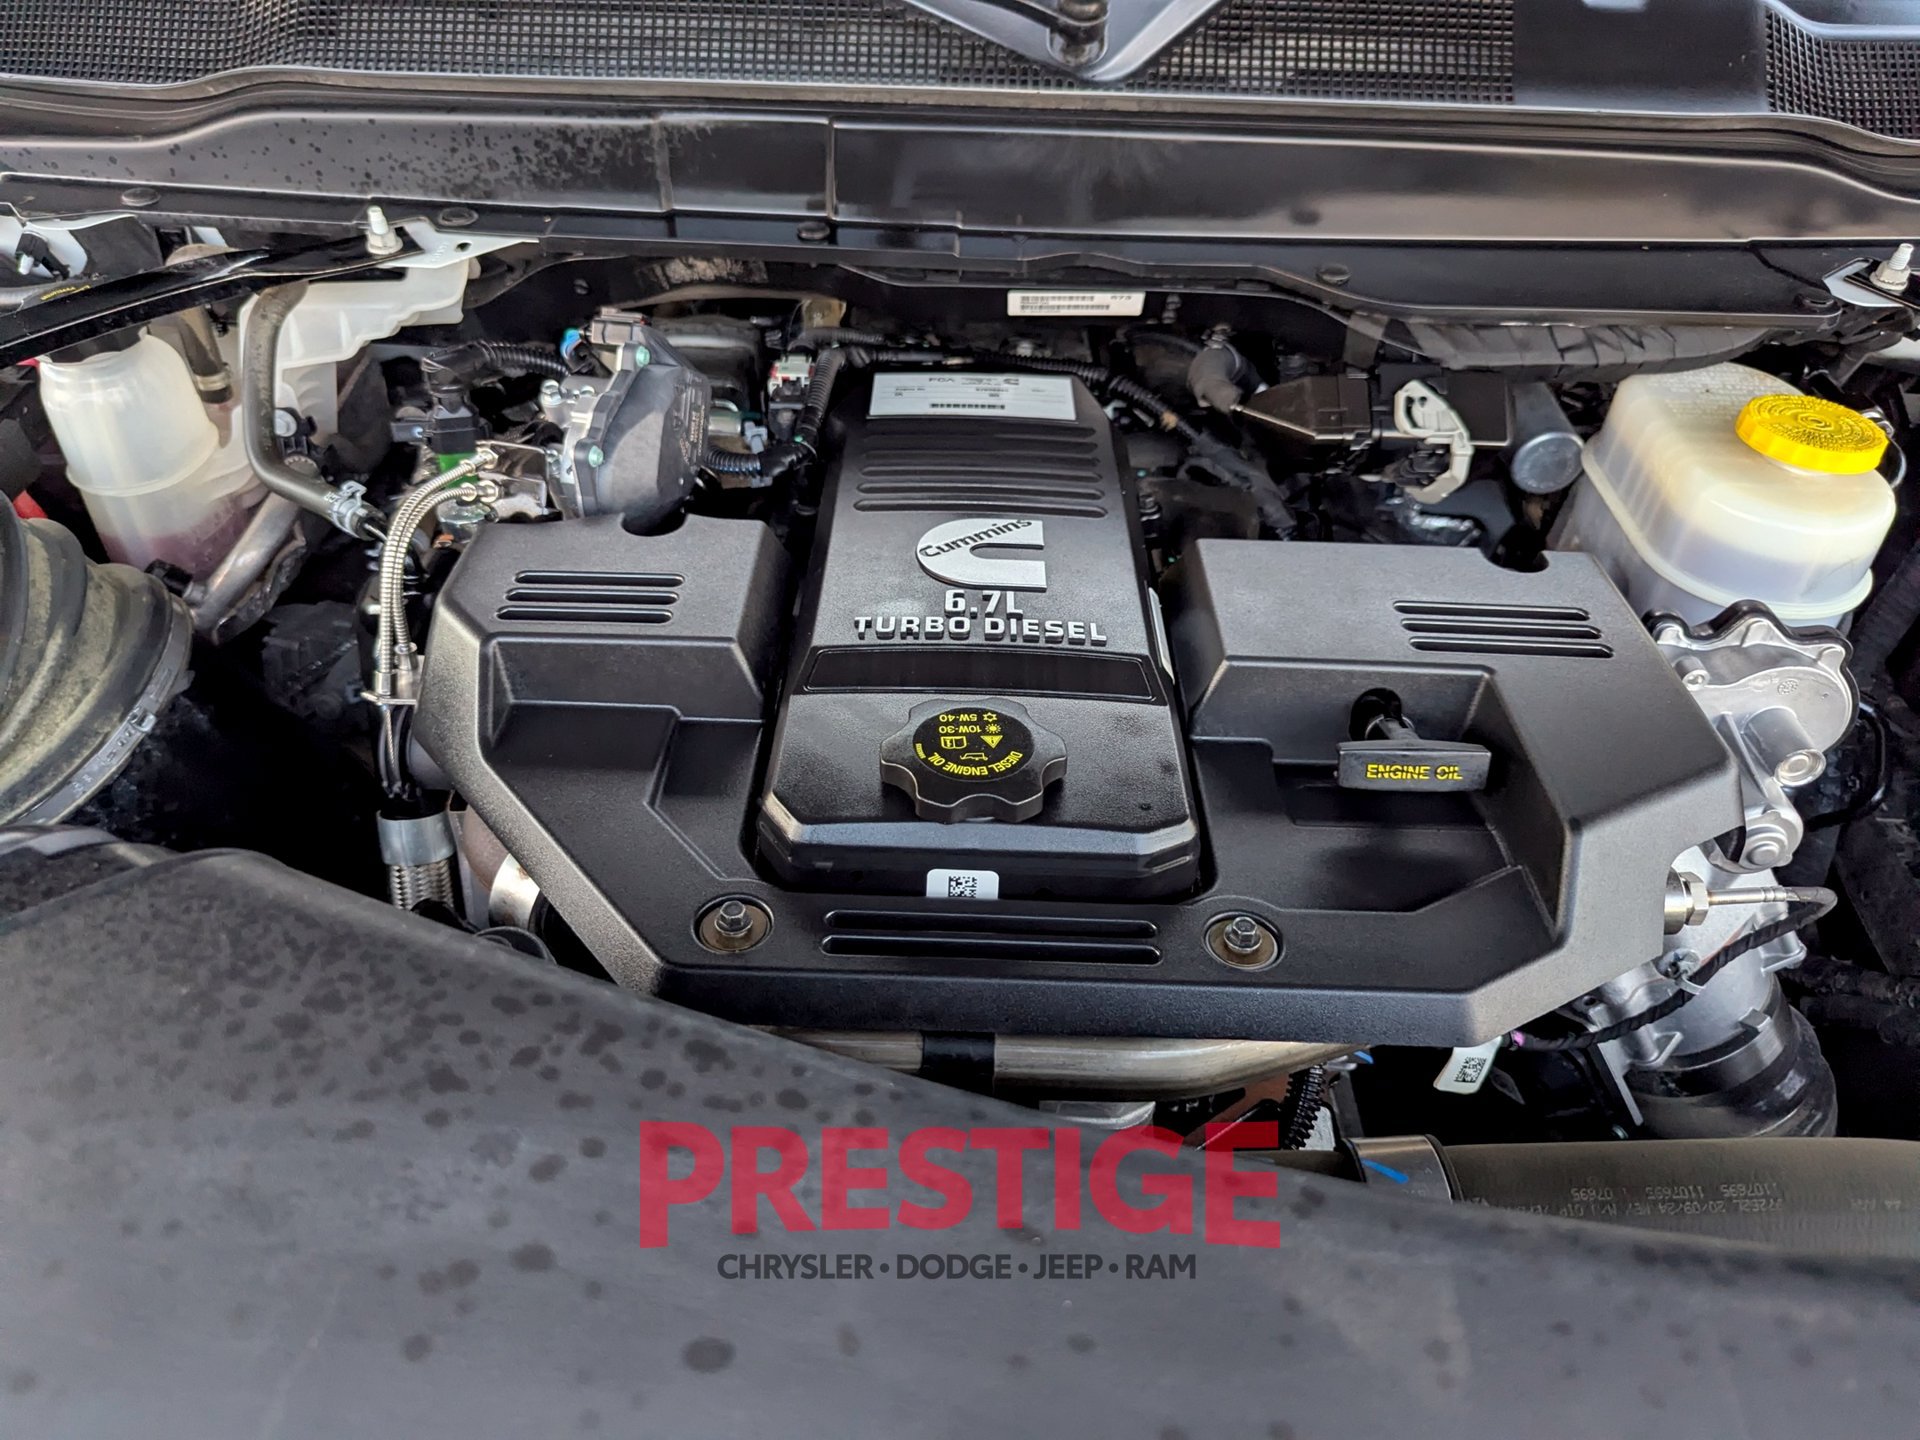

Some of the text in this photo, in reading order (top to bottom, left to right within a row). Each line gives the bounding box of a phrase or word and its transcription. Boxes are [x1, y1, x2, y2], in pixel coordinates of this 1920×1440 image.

[918, 518, 1033, 558] Cummins
[944, 589, 1023, 620] 6.7L
[854, 616, 1107, 647] TURBO DIESEL
[939, 725, 982, 734] 10W-30
[940, 714, 978, 722] 5W-40
[927, 751, 1023, 776] DIESEL ENGINE OIL
[1365, 763, 1464, 781] ENGINE OIL
